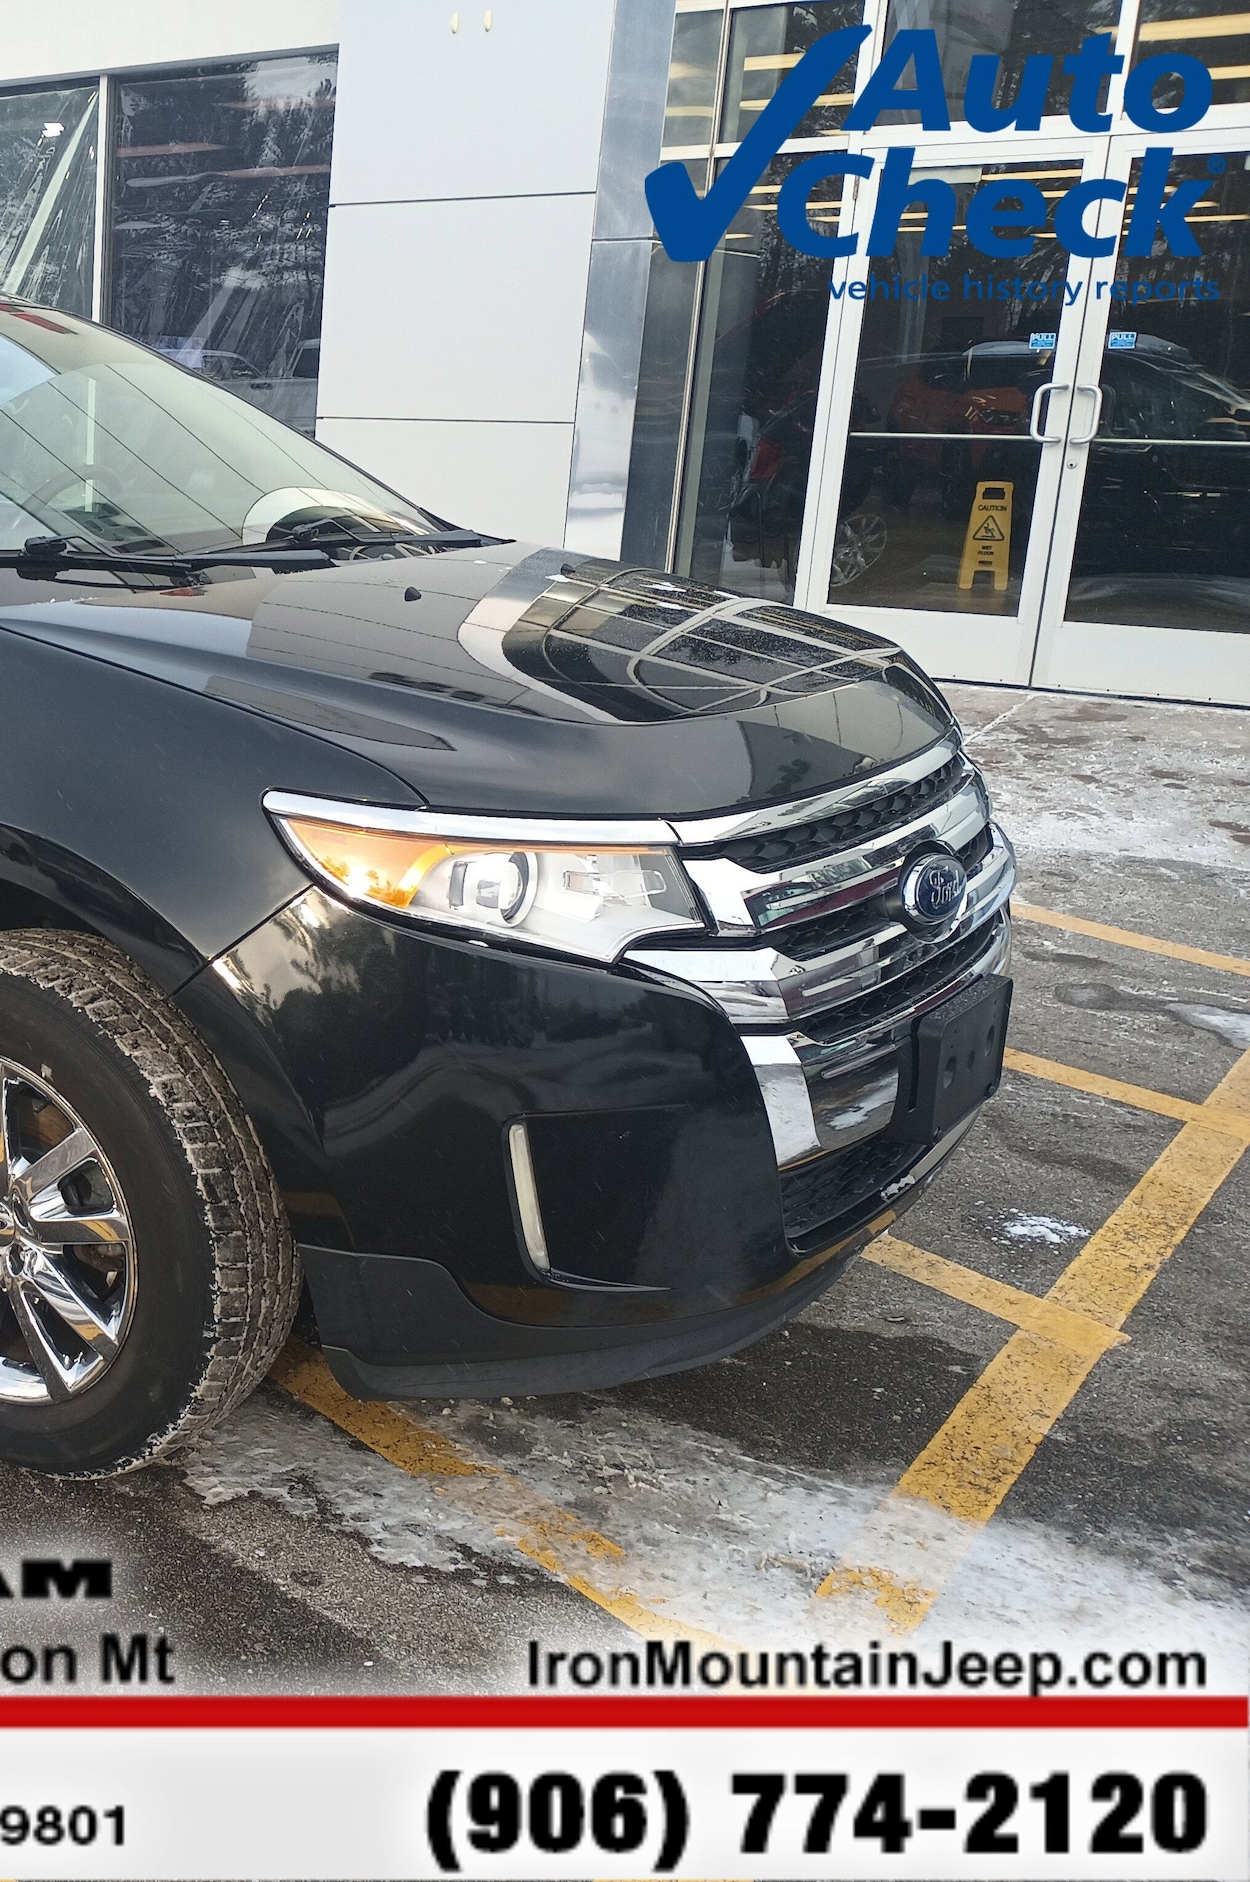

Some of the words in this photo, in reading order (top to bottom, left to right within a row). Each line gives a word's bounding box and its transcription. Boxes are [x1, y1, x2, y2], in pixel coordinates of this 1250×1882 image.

[1111, 333, 1135, 341] PULL
[977, 504, 1008, 512] CAUTION
[929, 866, 962, 909] Ford
